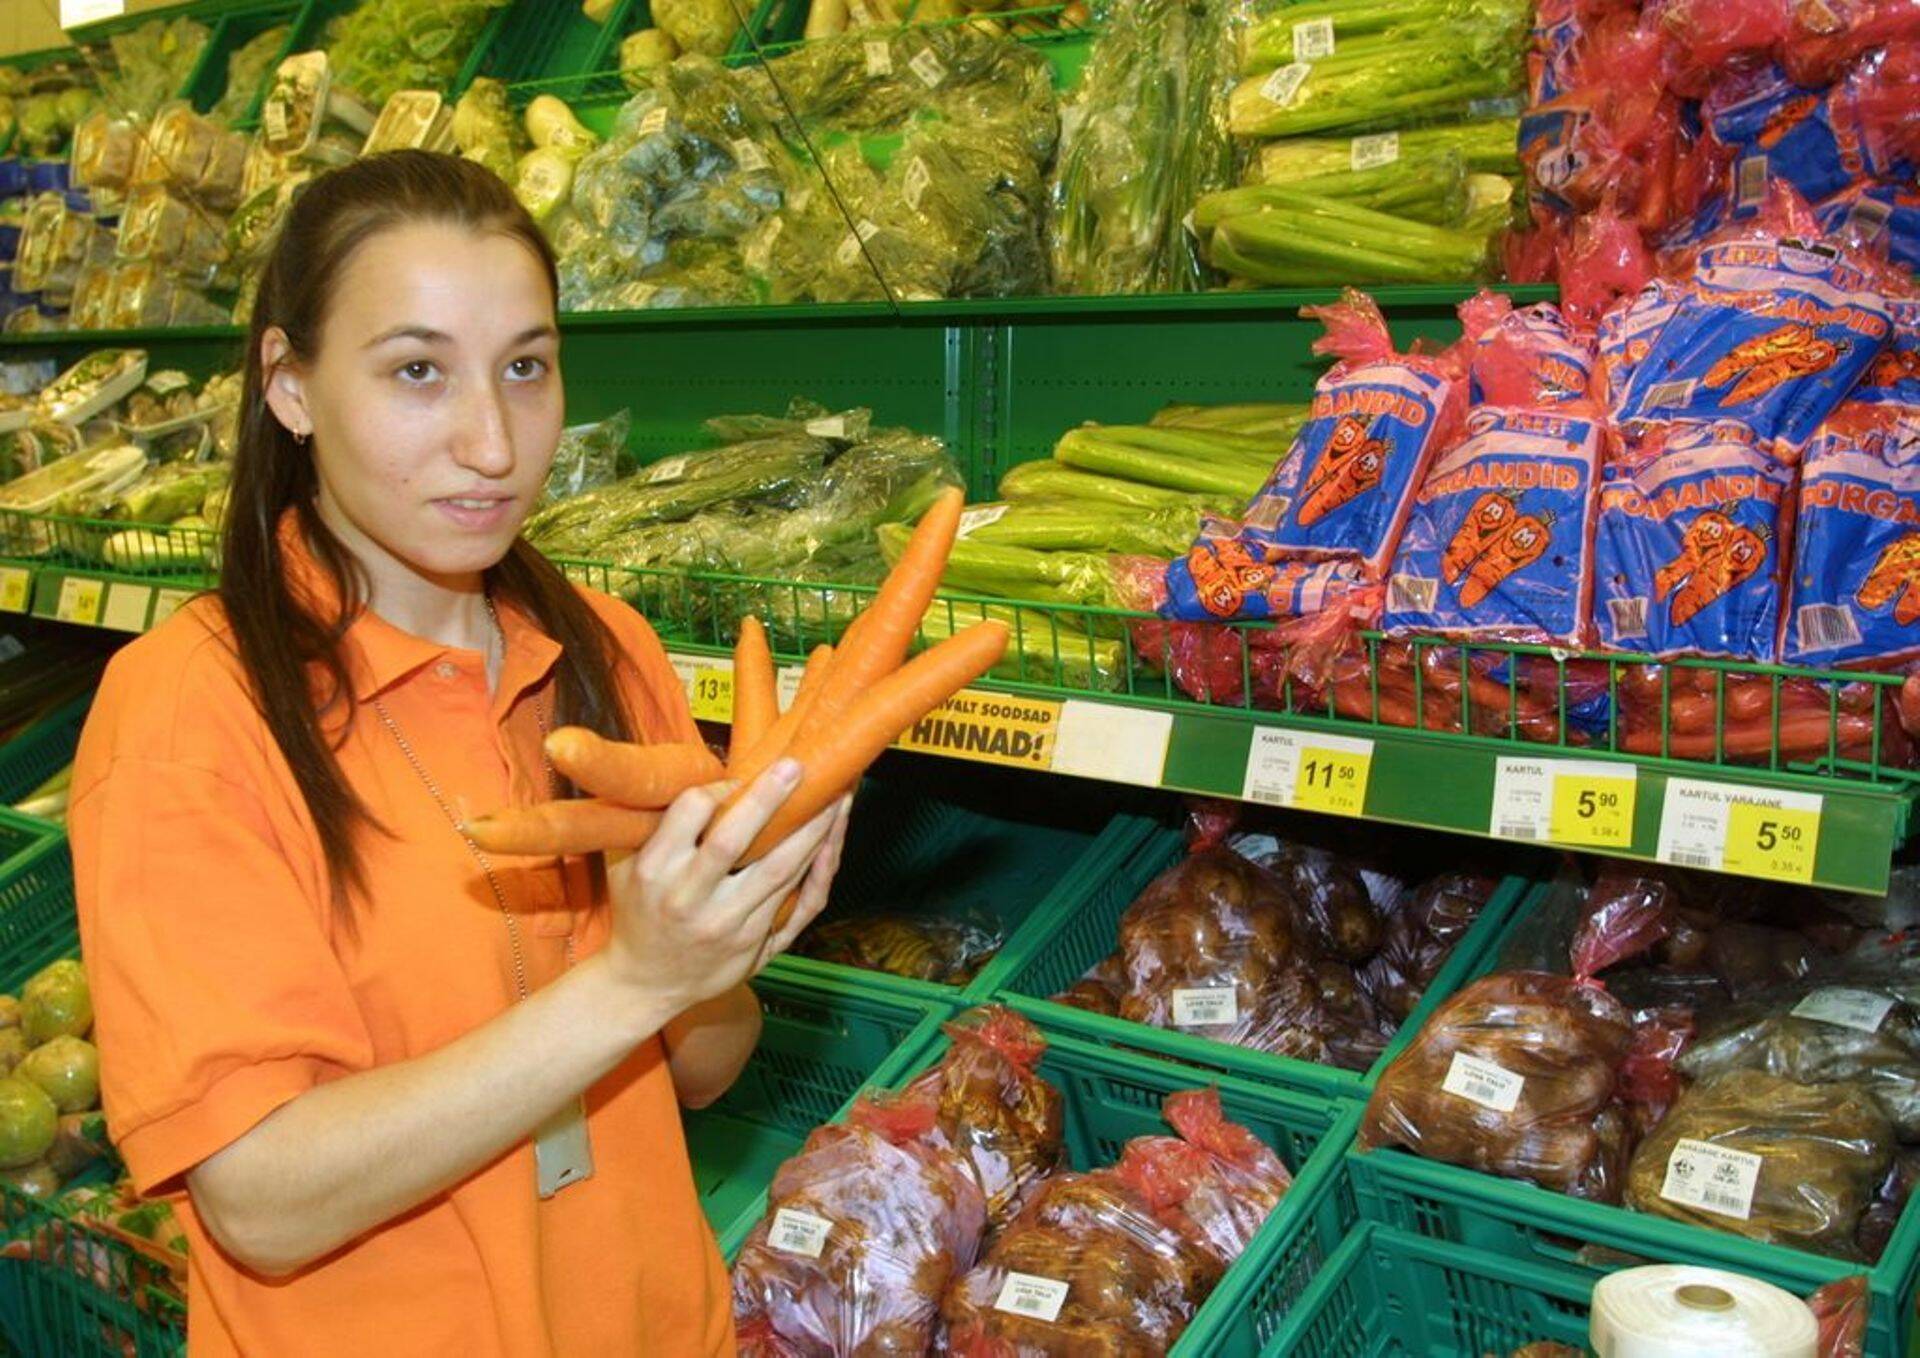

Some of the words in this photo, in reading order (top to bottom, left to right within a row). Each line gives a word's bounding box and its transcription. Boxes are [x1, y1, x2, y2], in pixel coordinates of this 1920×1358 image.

[698, 679, 718, 701] 13
[981, 703, 1051, 723] SOODSAD
[911, 718, 1045, 761] HINNAD!
[1261, 735, 1293, 746] KARTUL
[1305, 760, 1334, 788] 11
[1338, 767, 1354, 780] 50
[1505, 764, 1543, 776] KARTUL
[1577, 790, 1596, 818] 5
[1599, 793, 1617, 807] 90
[1679, 788, 1721, 802] KARTUL
[1725, 793, 1782, 809] VARAJANE
[1756, 821, 1778, 851] 5
[1781, 825, 1801, 841] 50
